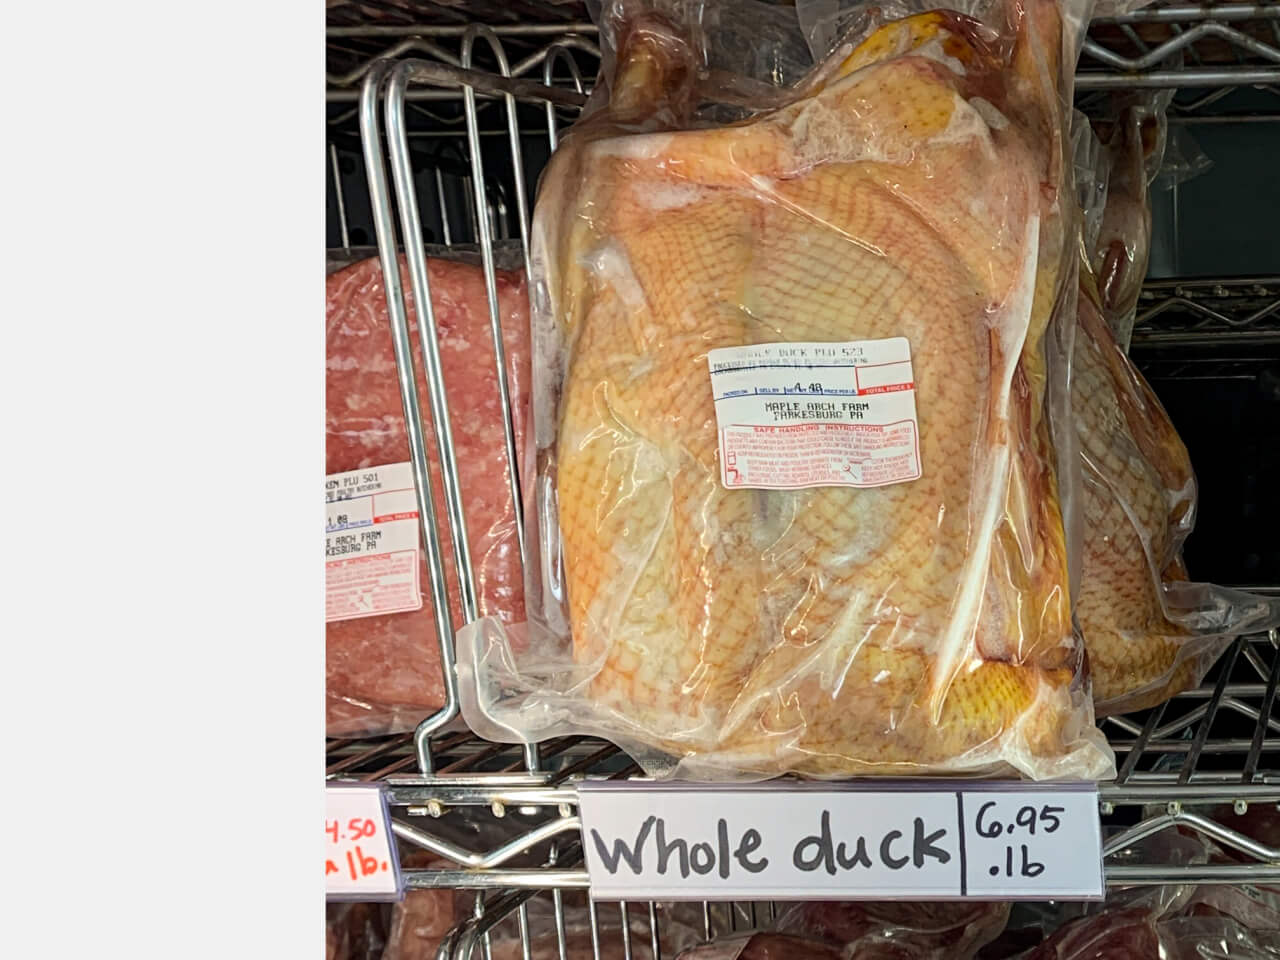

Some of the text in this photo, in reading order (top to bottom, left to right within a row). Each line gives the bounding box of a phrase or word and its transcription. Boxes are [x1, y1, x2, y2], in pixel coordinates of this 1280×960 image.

[765, 402, 800, 412] MAPLE
[841, 402, 870, 411] FARM
[849, 410, 864, 420] PA
[360, 530, 382, 542] FARM
[366, 540, 377, 551] PA
[975, 801, 1065, 839] 6.95
[591, 810, 952, 880] Whole duck
